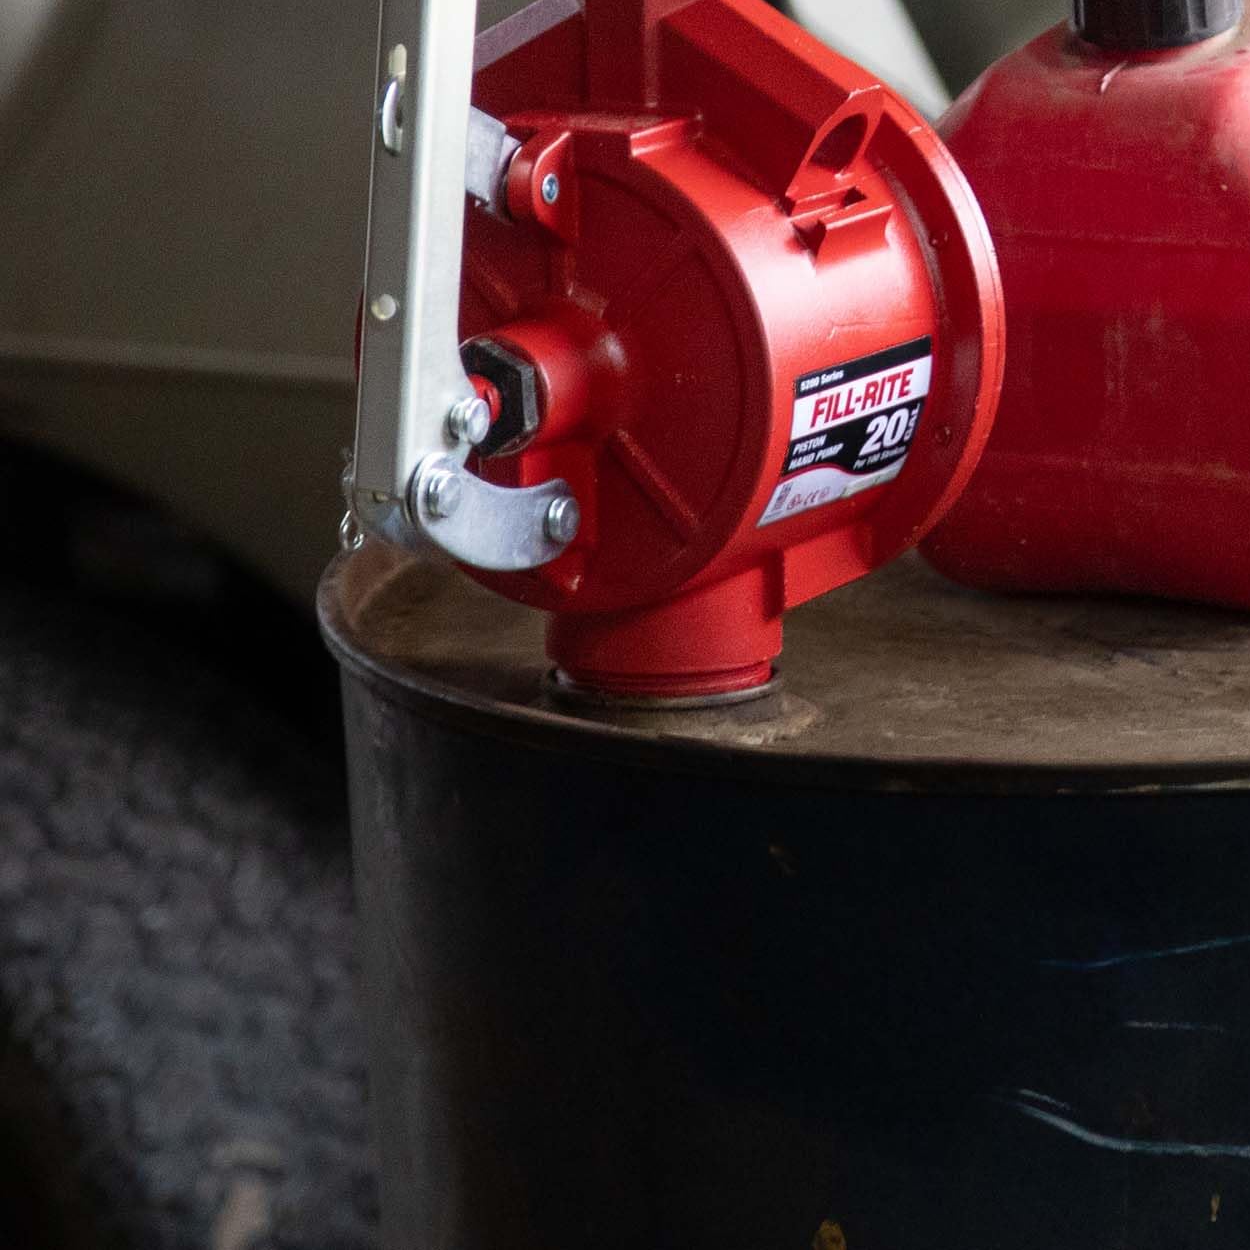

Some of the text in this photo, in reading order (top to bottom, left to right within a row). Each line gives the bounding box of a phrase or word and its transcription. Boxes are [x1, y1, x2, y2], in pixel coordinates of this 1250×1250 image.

[821, 369, 844, 386] Series
[810, 368, 914, 429] FILL-RITE
[859, 408, 909, 456] 20
[904, 403, 920, 441] GAL
[788, 443, 844, 470] HAND PUMP
[793, 434, 827, 455] PISTON
